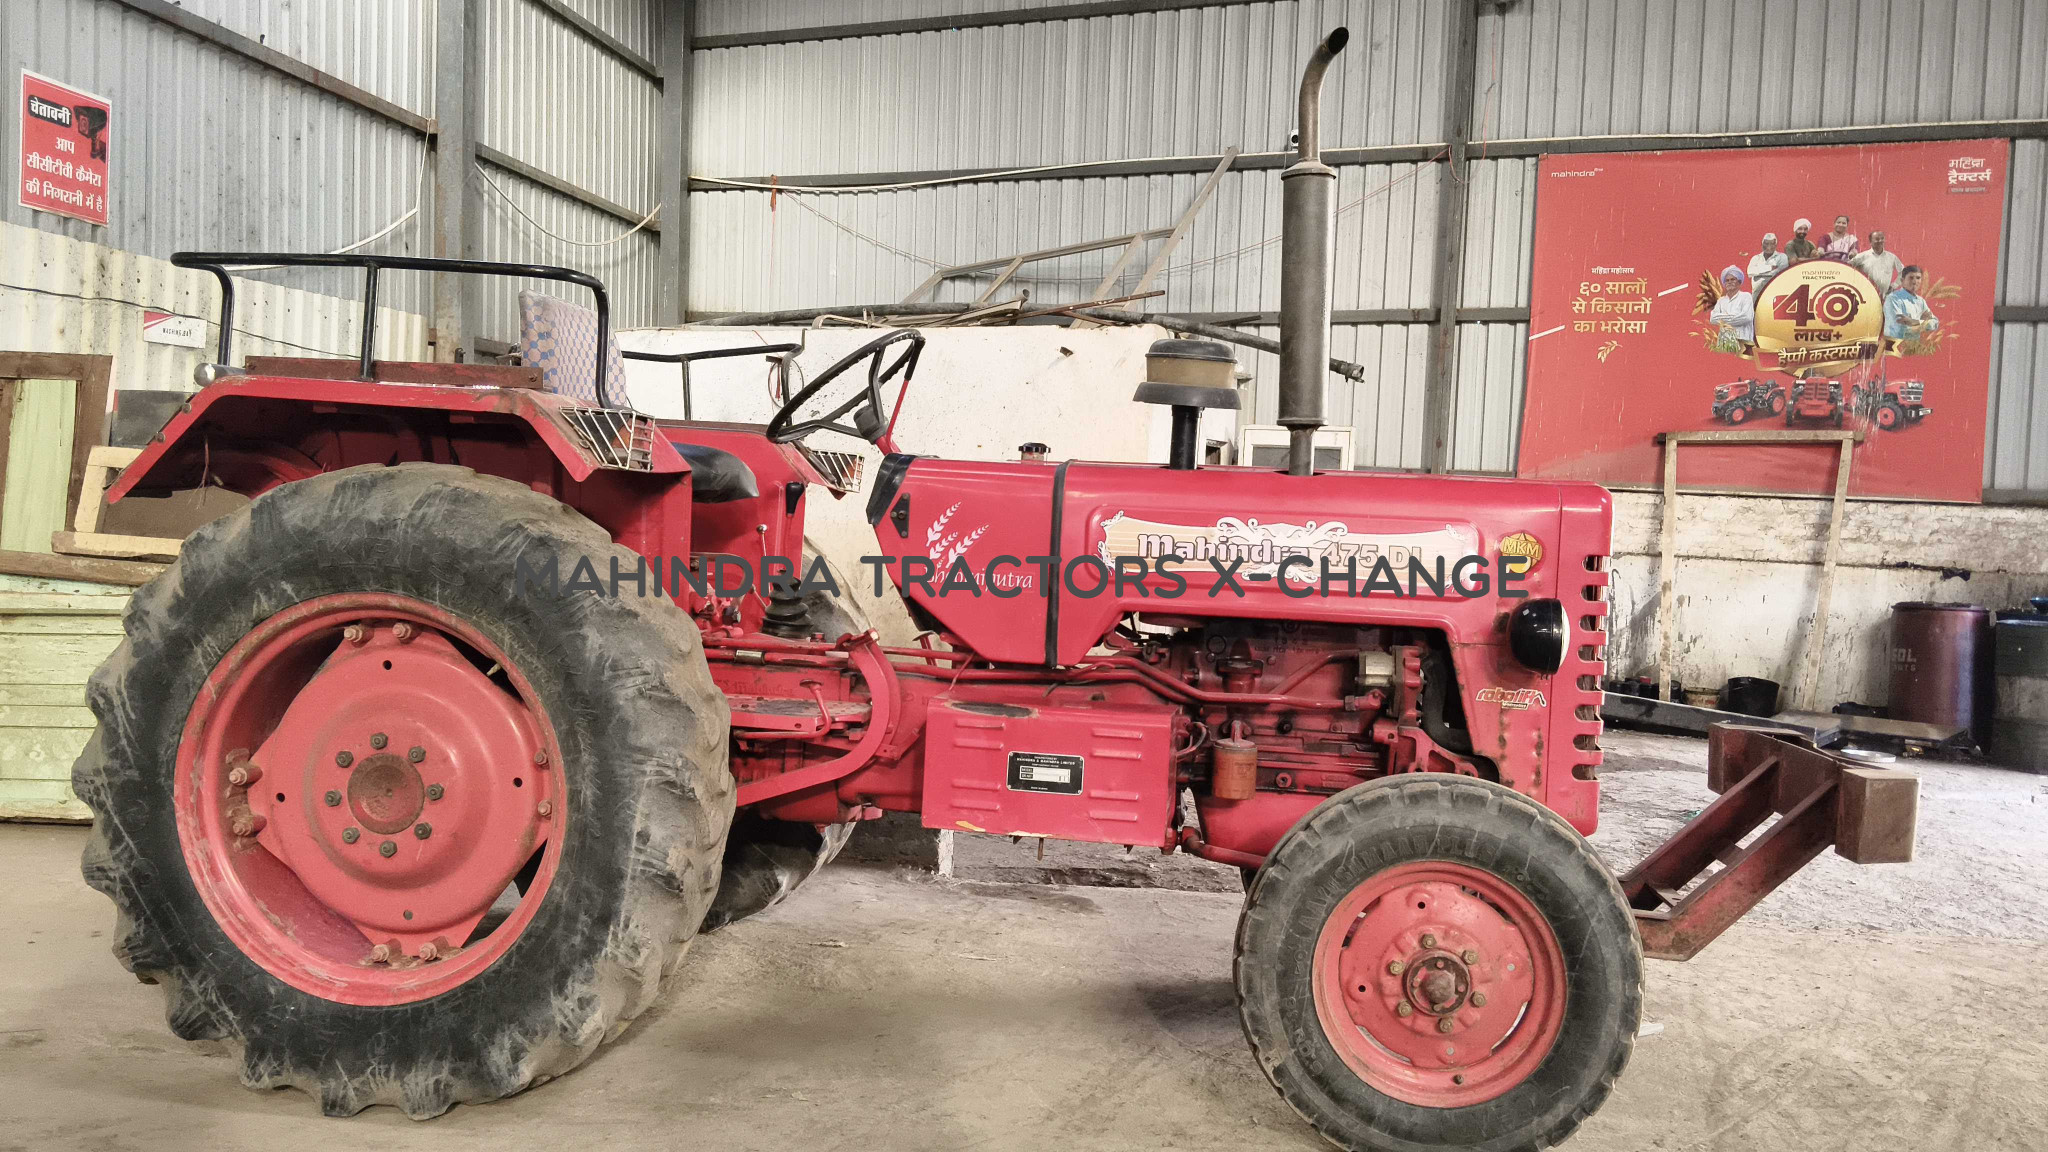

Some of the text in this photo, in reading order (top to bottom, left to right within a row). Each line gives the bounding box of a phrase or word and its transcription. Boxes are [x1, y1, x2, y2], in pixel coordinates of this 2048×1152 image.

[30, 97, 72, 125] चेतावनी
[55, 137, 75, 154] आप
[26, 152, 102, 187] सीसीटीवी कैमेरा
[1551, 170, 1596, 178] mahindra
[1948, 168, 1992, 185] ट्रैक्टर्स
[25, 179, 103, 213] की निगरानी में है
[1580, 277, 1648, 296] ६० सालों
[1571, 296, 1653, 314] से किसानों
[162, 328, 182, 336] WASHING
[1573, 316, 1648, 334] का भरोसा
[1778, 341, 1862, 366] हैप्पी कस्टमर्स
[1137, 534, 1422, 570] Mahindra 475 DI
[1503, 538, 1540, 558] MKM
